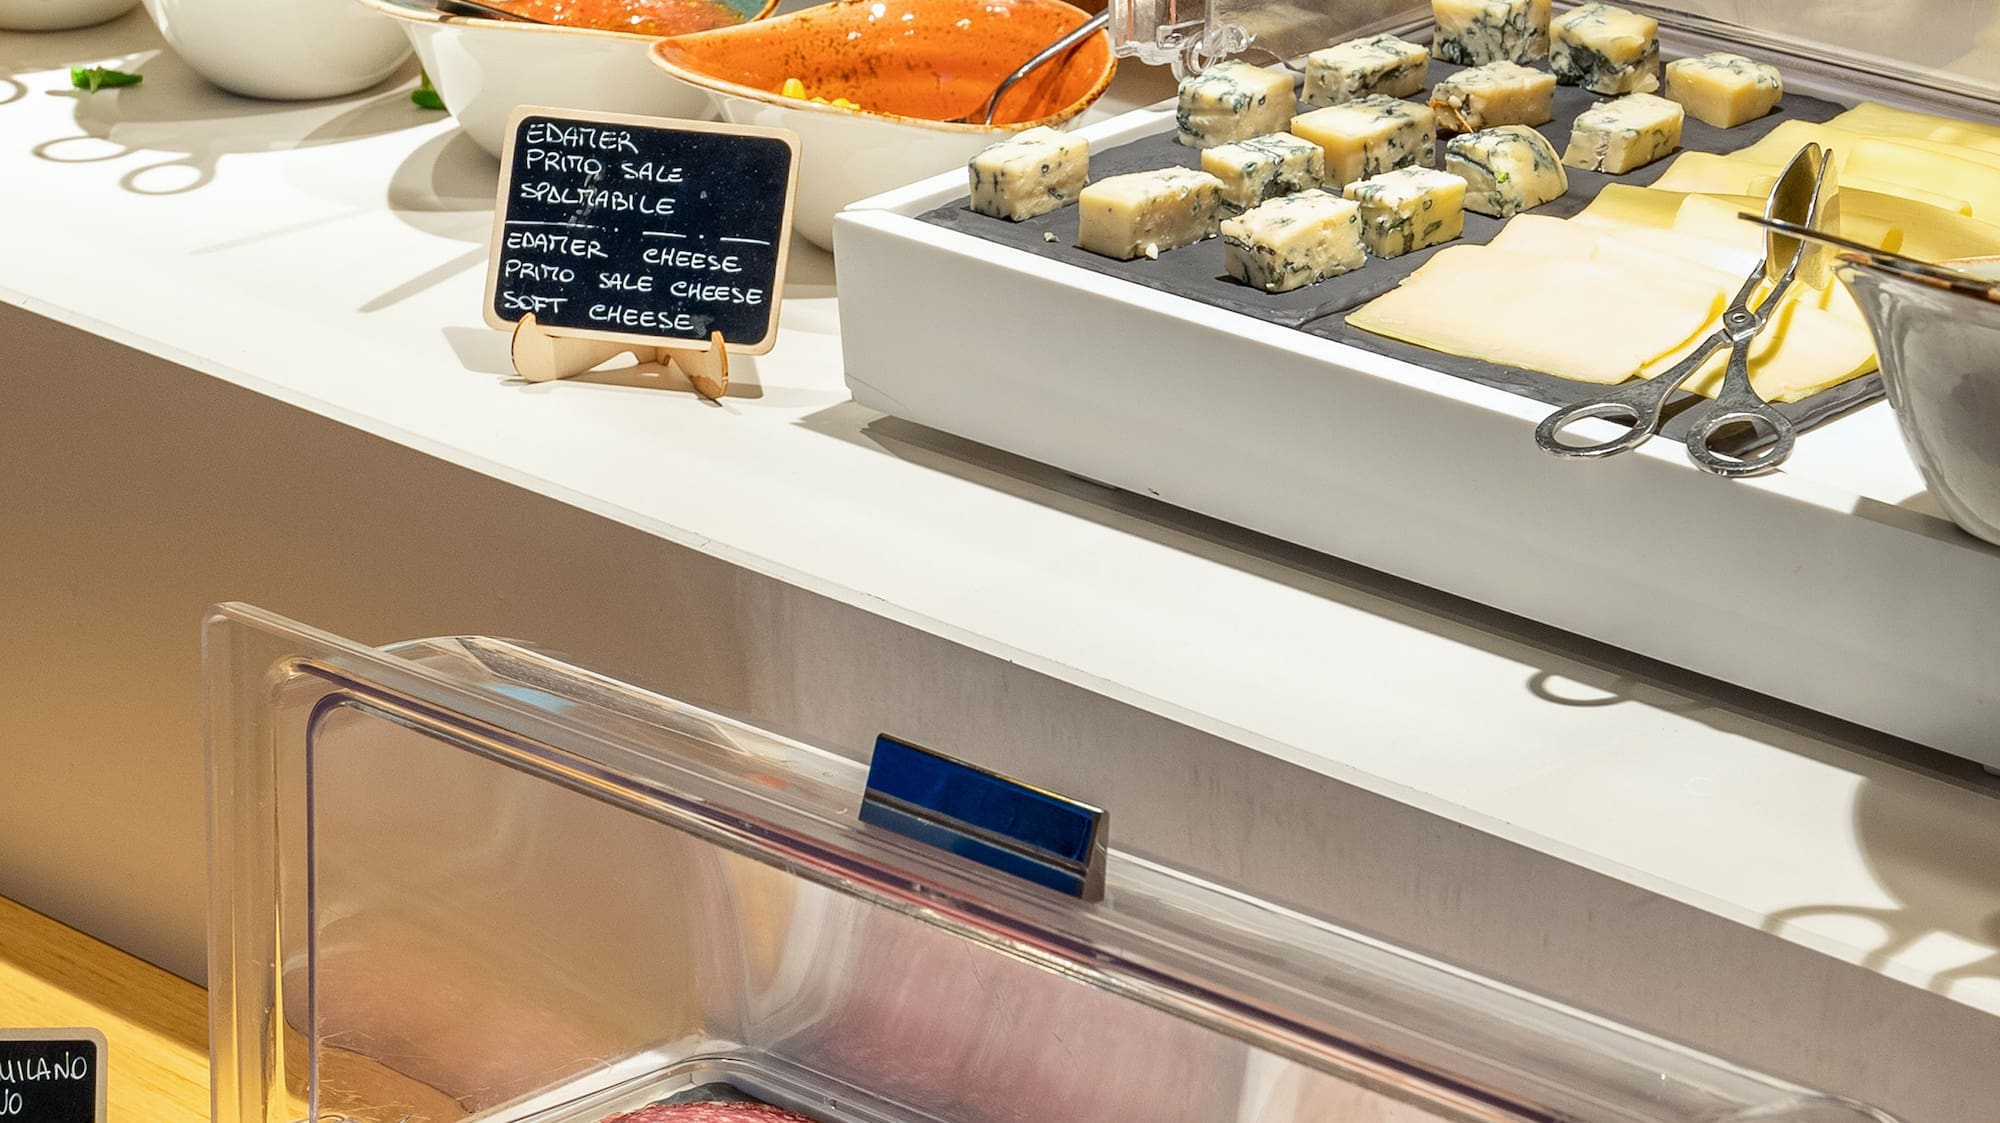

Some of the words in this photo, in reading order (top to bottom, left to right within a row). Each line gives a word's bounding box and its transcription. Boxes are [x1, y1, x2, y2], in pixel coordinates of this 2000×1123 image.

[526, 122, 639, 153] EDAMER
[526, 149, 603, 175] PRIMO
[621, 162, 684, 183] SALE
[520, 182, 676, 215] SPALMABILE
[506, 232, 608, 258] EDAMER
[642, 248, 743, 273] CHEESE
[505, 260, 575, 283] PRIMO
[598, 272, 654, 292] SALE
[670, 281, 763, 305] CHEESE
[503, 291, 568, 314] SOFT
[588, 304, 695, 331] CHEESE
